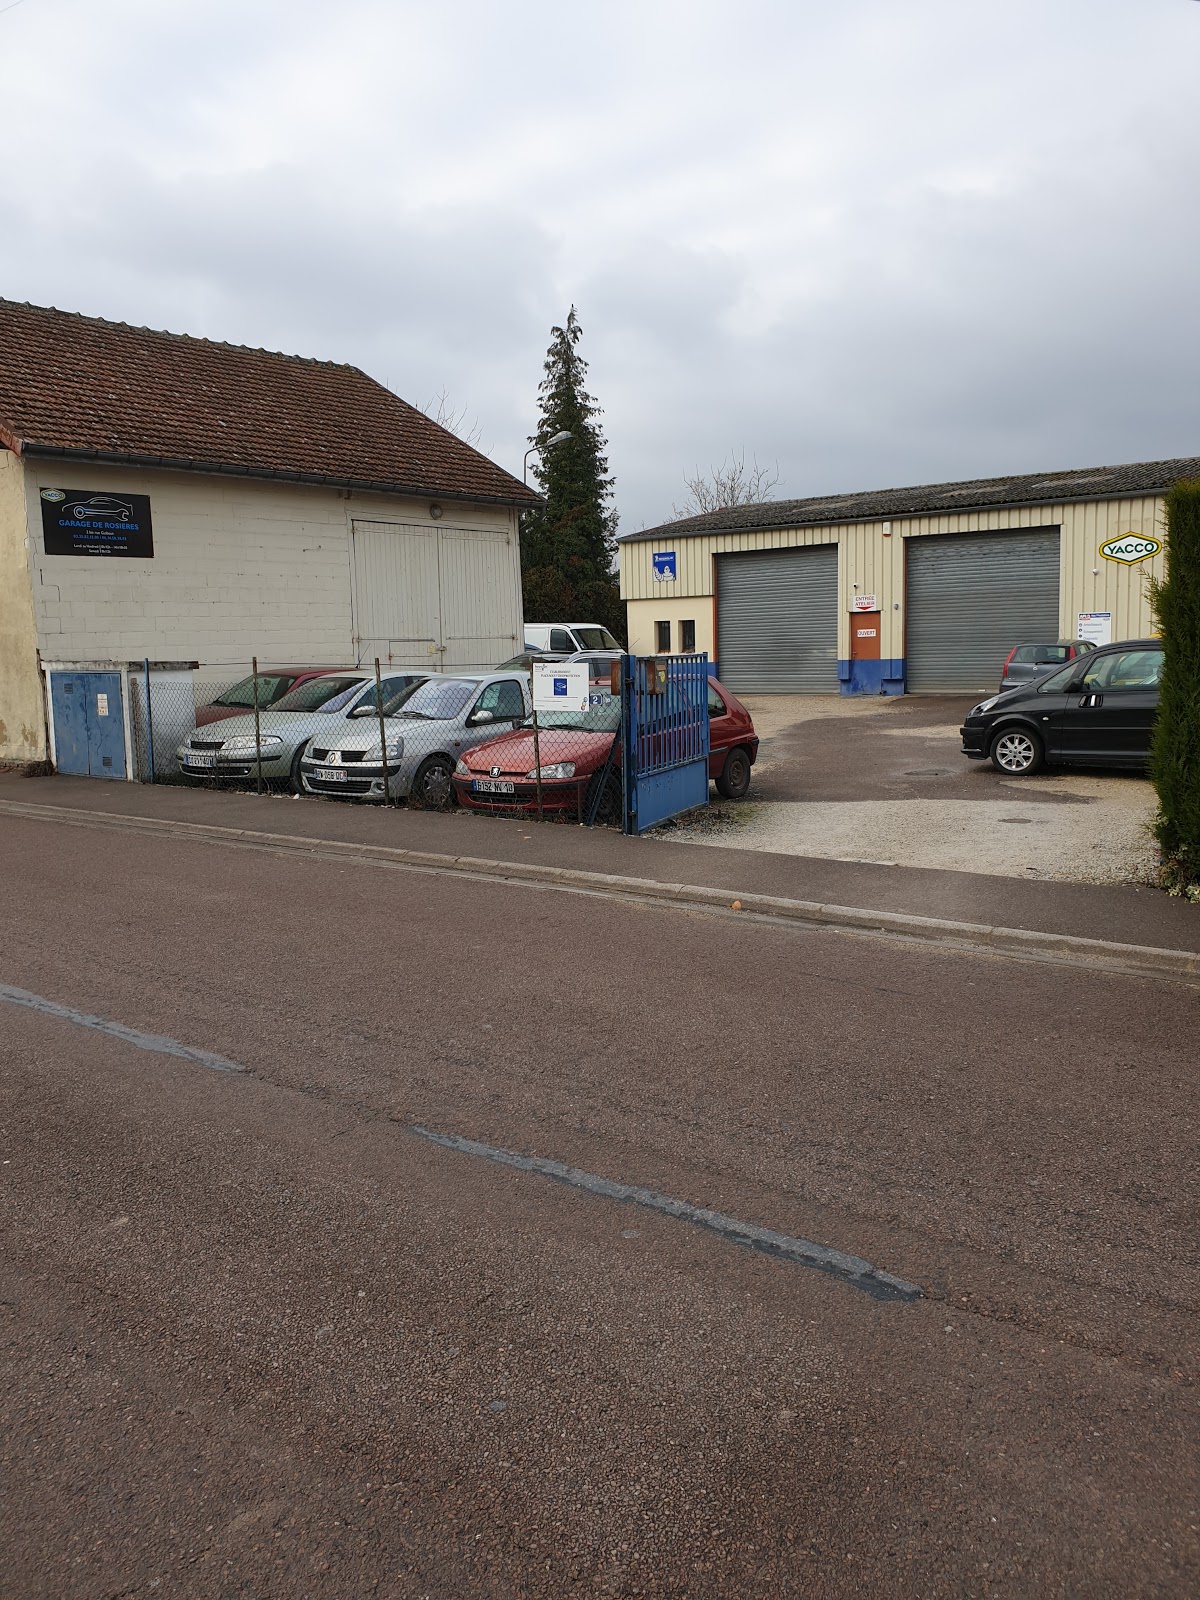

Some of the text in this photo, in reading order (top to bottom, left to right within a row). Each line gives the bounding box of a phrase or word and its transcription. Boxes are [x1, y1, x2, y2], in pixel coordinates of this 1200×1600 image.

[59, 519, 139, 530] GARAGE DE ROSIERES
[1107, 542, 1155, 555] YACCO
[592, 695, 598, 705] 2
